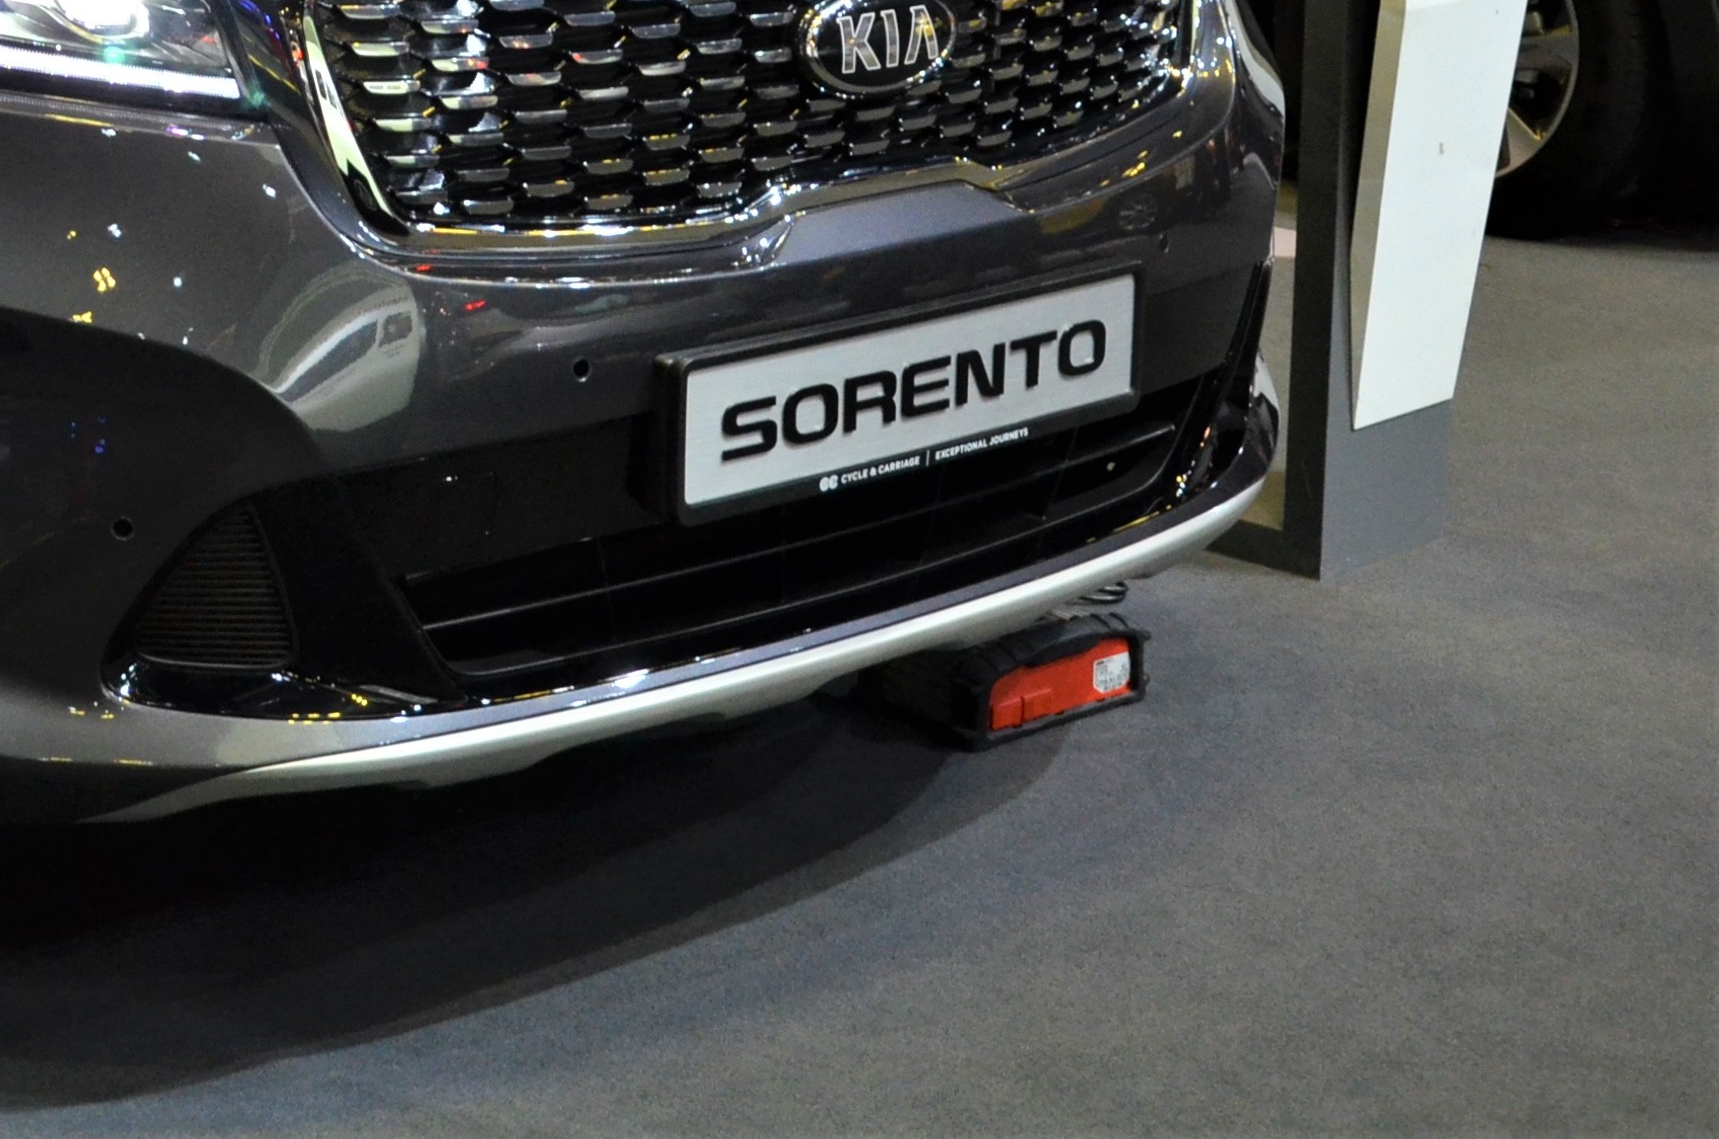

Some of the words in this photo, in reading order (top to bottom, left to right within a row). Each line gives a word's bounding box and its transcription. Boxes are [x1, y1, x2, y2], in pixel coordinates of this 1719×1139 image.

[836, 4, 939, 74] KIA
[721, 319, 1106, 463] SORENTO
[840, 468, 868, 484] CYCLE
[869, 466, 877, 477] &
[878, 455, 920, 475] CARRIAGE
[935, 438, 987, 460] EXCEPTIONAL
[989, 427, 1029, 446] JOURNEYS
